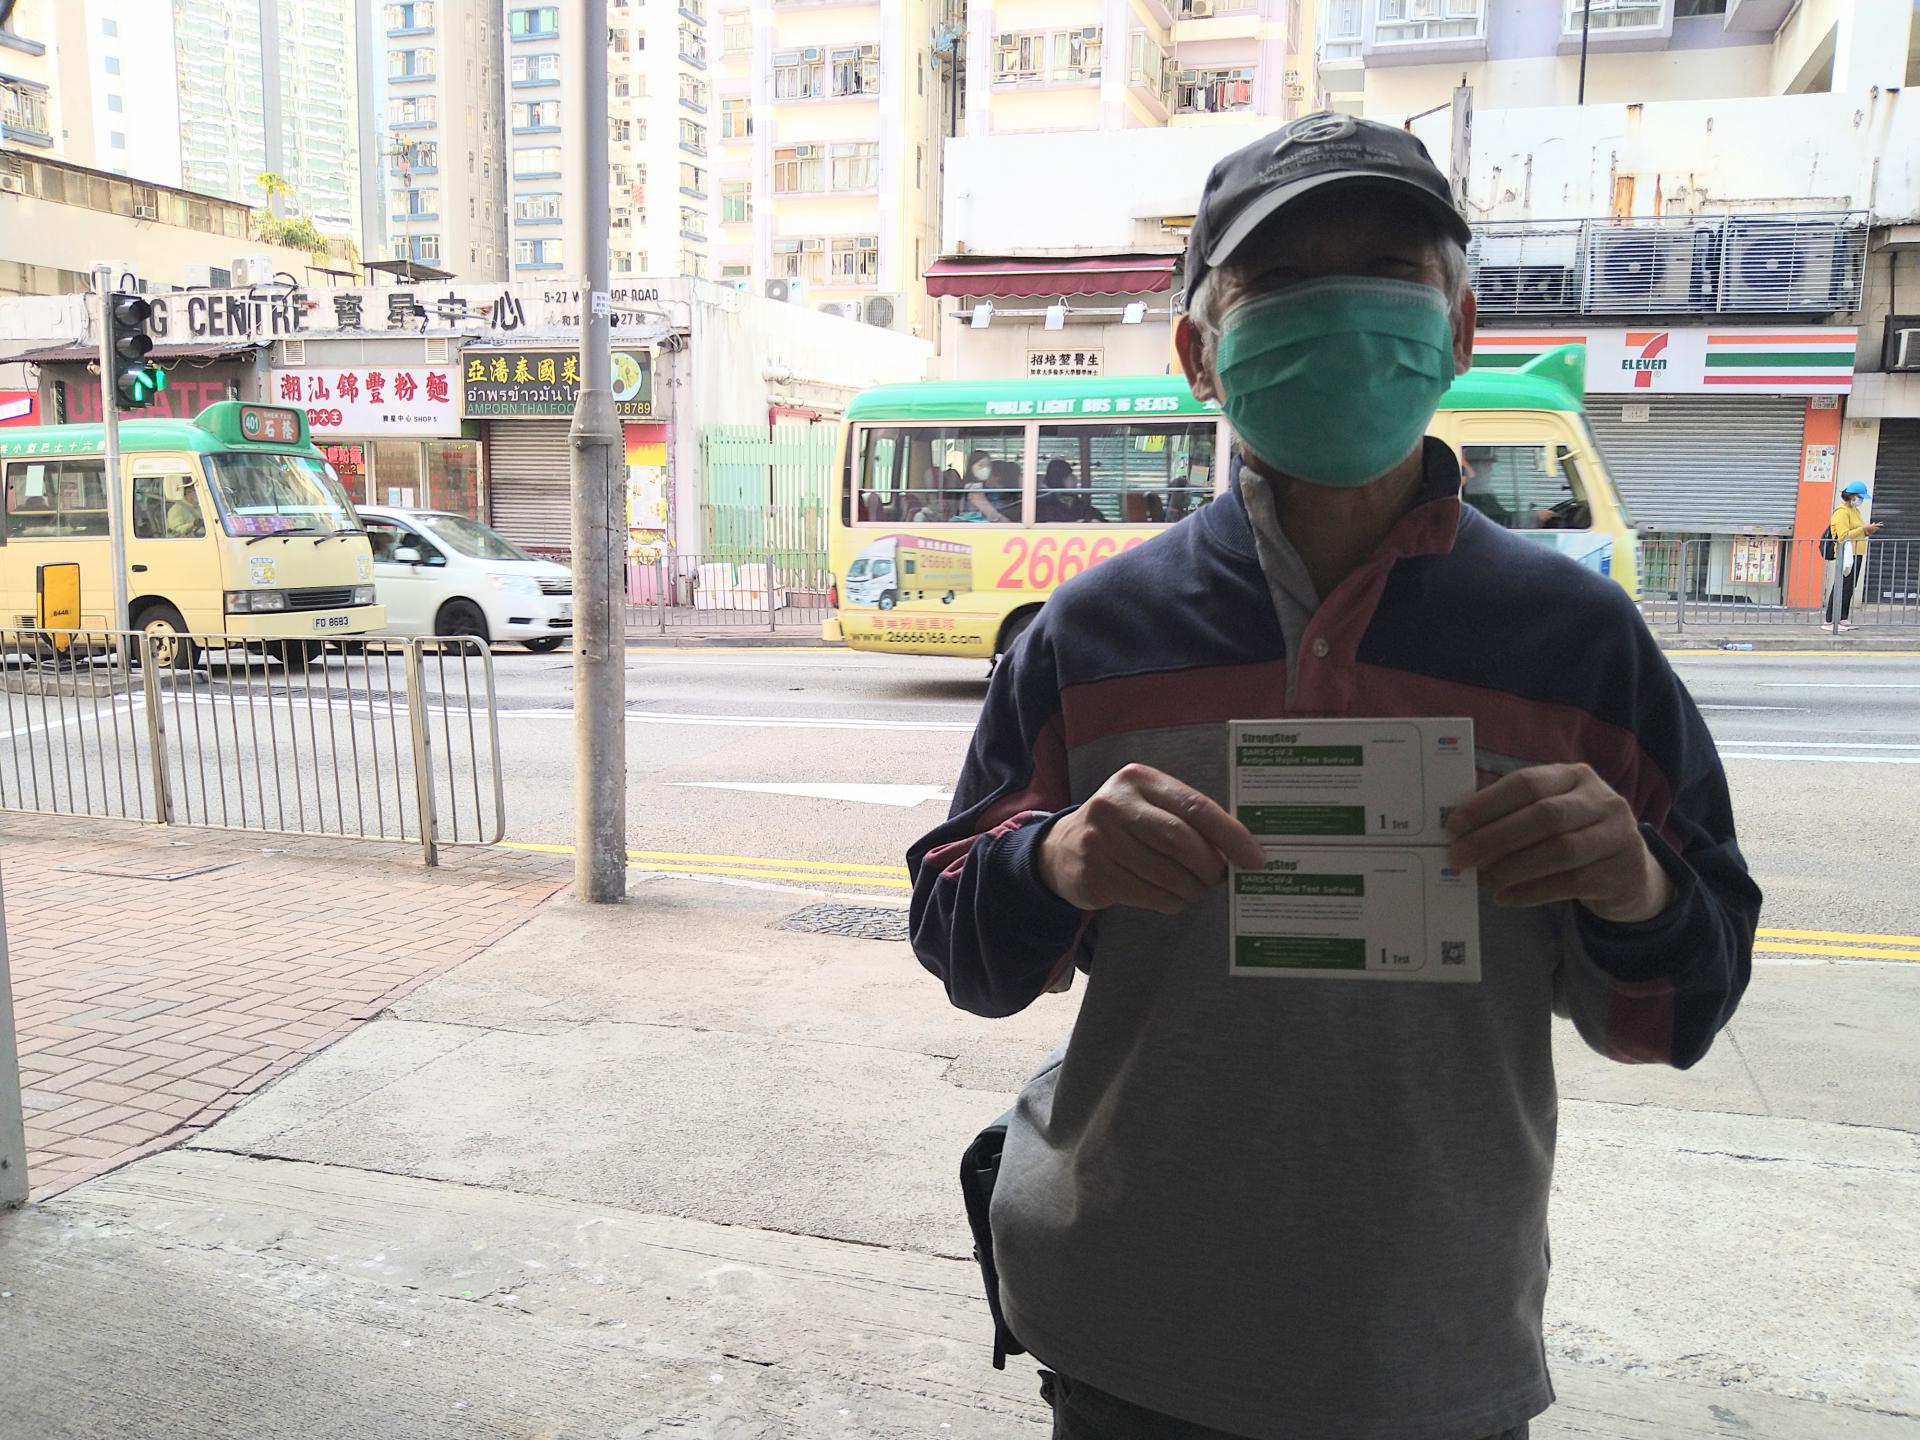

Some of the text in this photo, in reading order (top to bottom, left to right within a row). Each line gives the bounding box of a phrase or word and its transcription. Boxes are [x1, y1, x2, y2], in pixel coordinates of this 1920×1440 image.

[545, 292, 567, 303] 5-27
[631, 289, 658, 301] ROAD
[188, 294, 309, 337] CENTRE
[467, 403, 517, 414] AMPORN
[520, 403, 547, 414] THAI
[625, 402, 651, 414] 8789
[985, 397, 1179, 415] PUBLIC LIGHT BUS 16 SEATS
[246, 416, 259, 429] 401
[1242, 733, 1297, 744] StrongStep
[1379, 813, 1408, 830] 1 Test
[1380, 947, 1387, 964] 1
